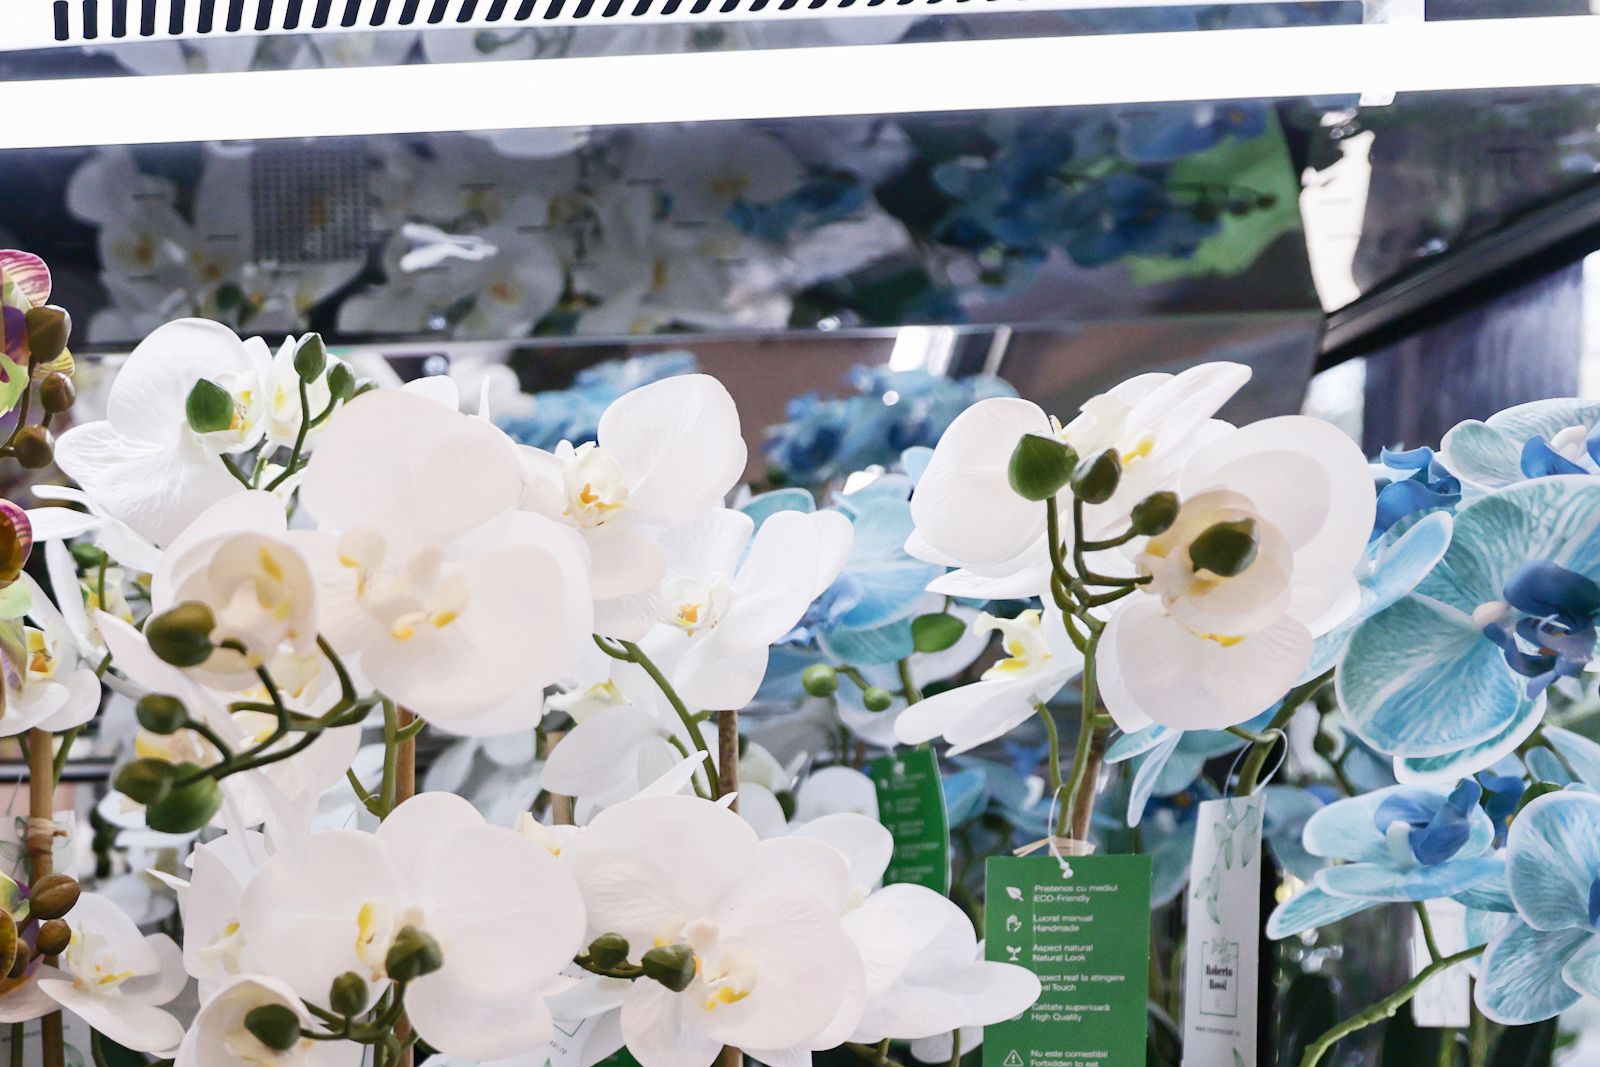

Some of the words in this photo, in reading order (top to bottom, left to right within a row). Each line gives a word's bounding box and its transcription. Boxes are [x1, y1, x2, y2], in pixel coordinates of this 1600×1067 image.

[1089, 884, 1119, 892] mediul
[1034, 894, 1091, 904] ECO-Friendly
[1033, 914, 1060, 922] Lucrat
[1062, 914, 1094, 922] manual
[1033, 924, 1080, 932] Handmade
[1032, 944, 1062, 952] Aspect
[1032, 954, 1063, 962] Natural
[1064, 954, 1086, 962] Look
[1038, 974, 1061, 982] spect
[1052, 983, 1077, 991] Touch
[1031, 1013, 1051, 1022] High
[1052, 1013, 1083, 1022] Quality
[1030, 1050, 1043, 1058] Nu
[1044, 1050, 1063, 1058] este
[1030, 1059, 1073, 1067] Forbidden
